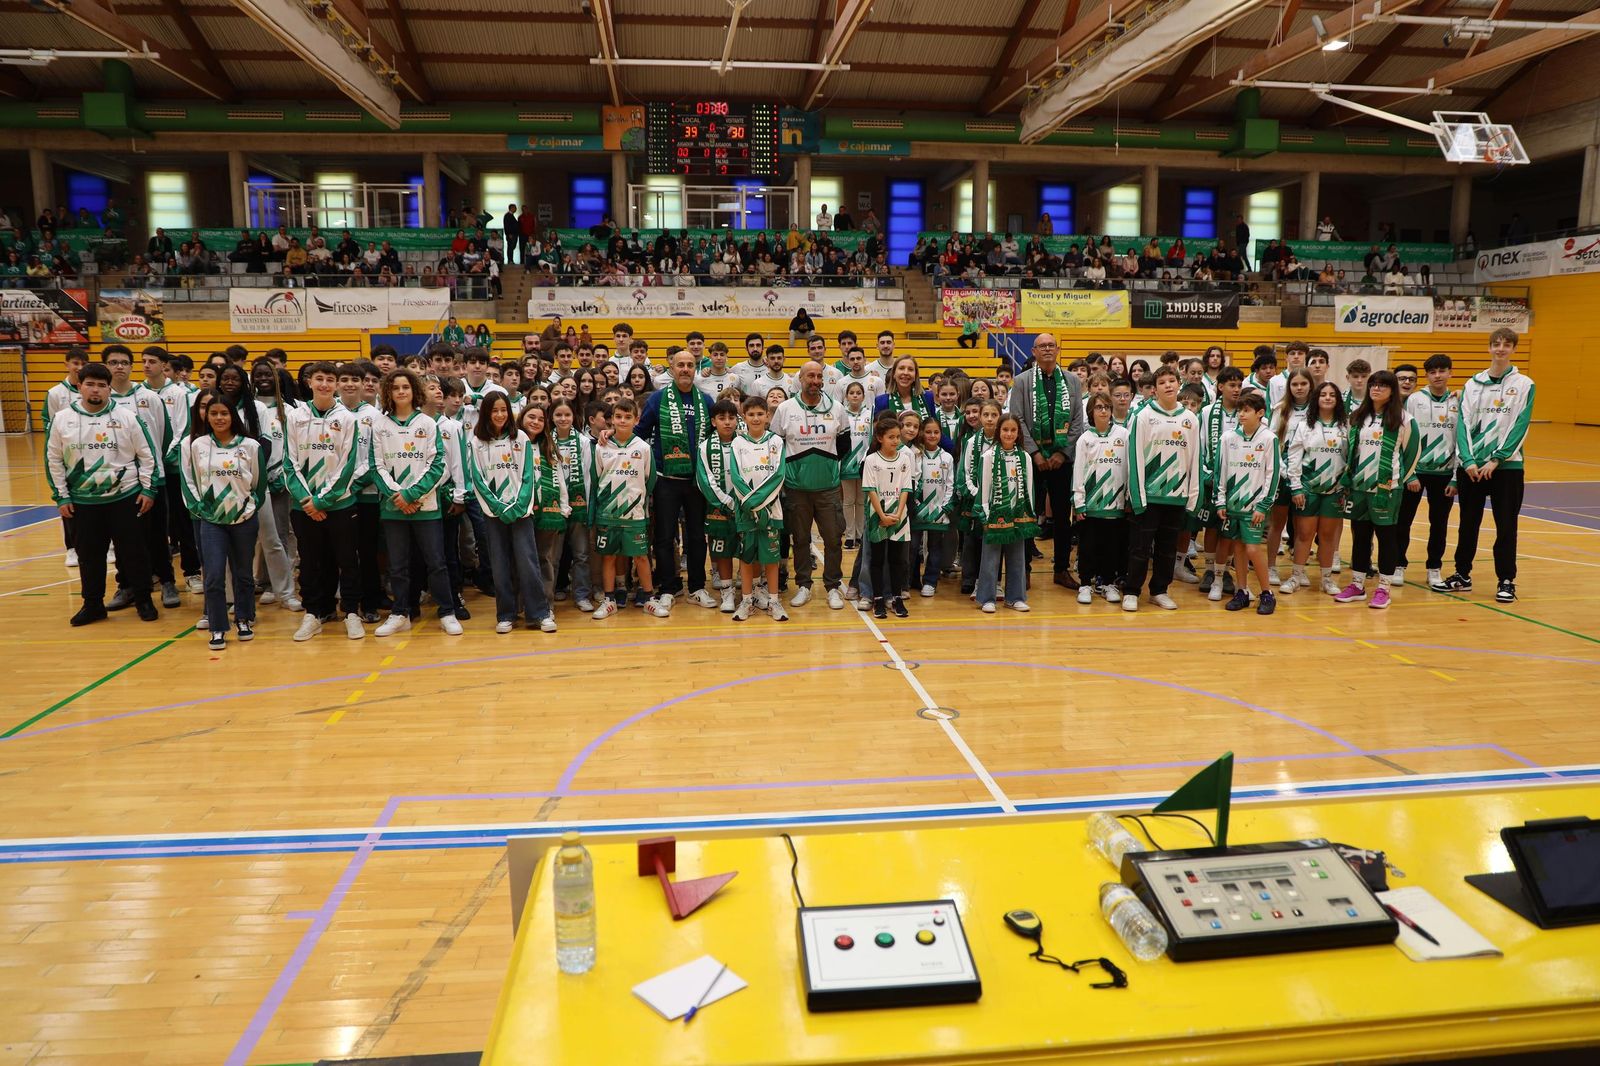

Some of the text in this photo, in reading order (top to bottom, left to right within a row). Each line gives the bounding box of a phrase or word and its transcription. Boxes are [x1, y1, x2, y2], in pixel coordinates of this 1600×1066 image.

[685, 126, 698, 138] 39
[732, 127, 745, 138] 30
[540, 137, 584, 149] cajamar
[849, 142, 893, 153] cajamar
[1056, 293, 1061, 301] y
[1063, 293, 1092, 301] Miguel
[1166, 302, 1222, 313] INDUSER
[1360, 310, 1430, 328] agroclean
[118, 325, 147, 336] OTTO
[718, 384, 724, 392] 9
[669, 401, 683, 434] MURGI
[70, 441, 118, 451] surseeds
[299, 442, 335, 452] surseed
[384, 451, 425, 460] surseeds
[890, 472, 894, 483] 1
[597, 535, 608, 549] 15
[712, 539, 725, 553] 18
